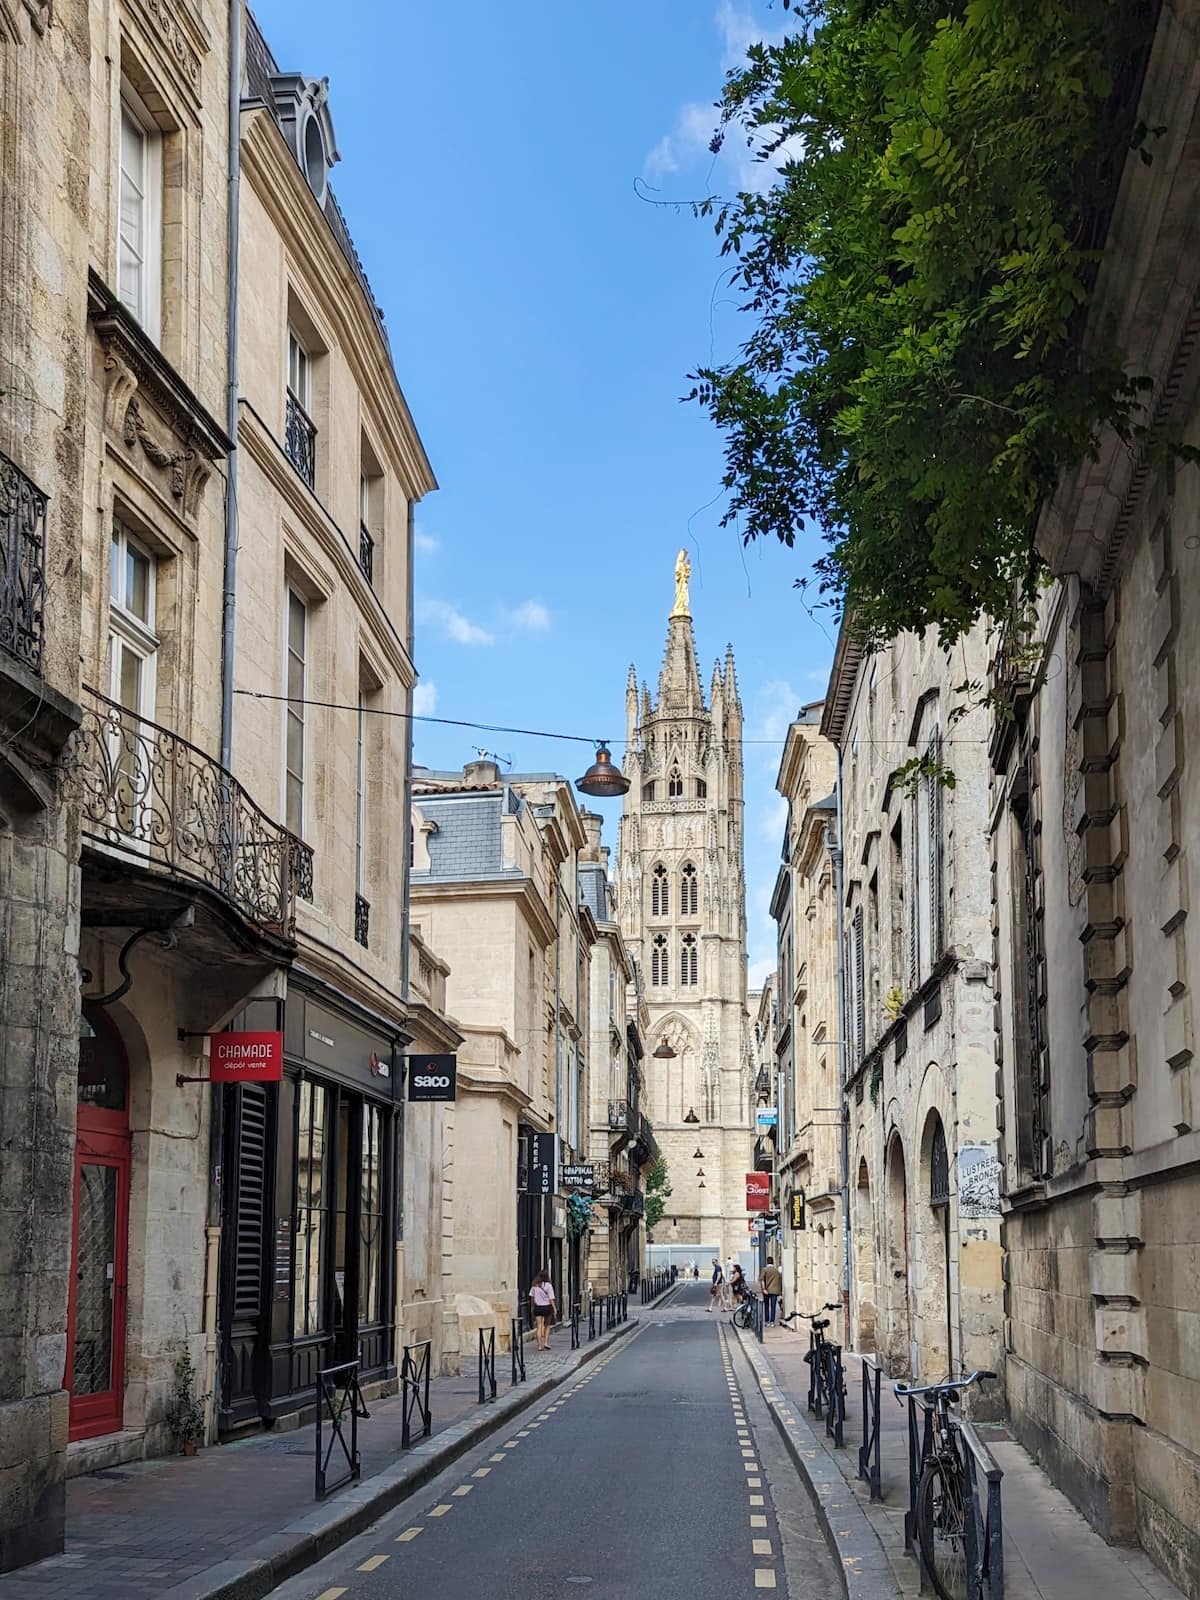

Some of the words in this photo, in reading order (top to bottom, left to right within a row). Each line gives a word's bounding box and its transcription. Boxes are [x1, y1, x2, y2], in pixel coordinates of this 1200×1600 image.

[218, 1044, 273, 1058] CHAMADE
[247, 1061, 267, 1069] vente
[414, 1075, 450, 1088] saco
[541, 1164, 550, 1193] SHOW
[564, 1176, 583, 1185] TATTOO
